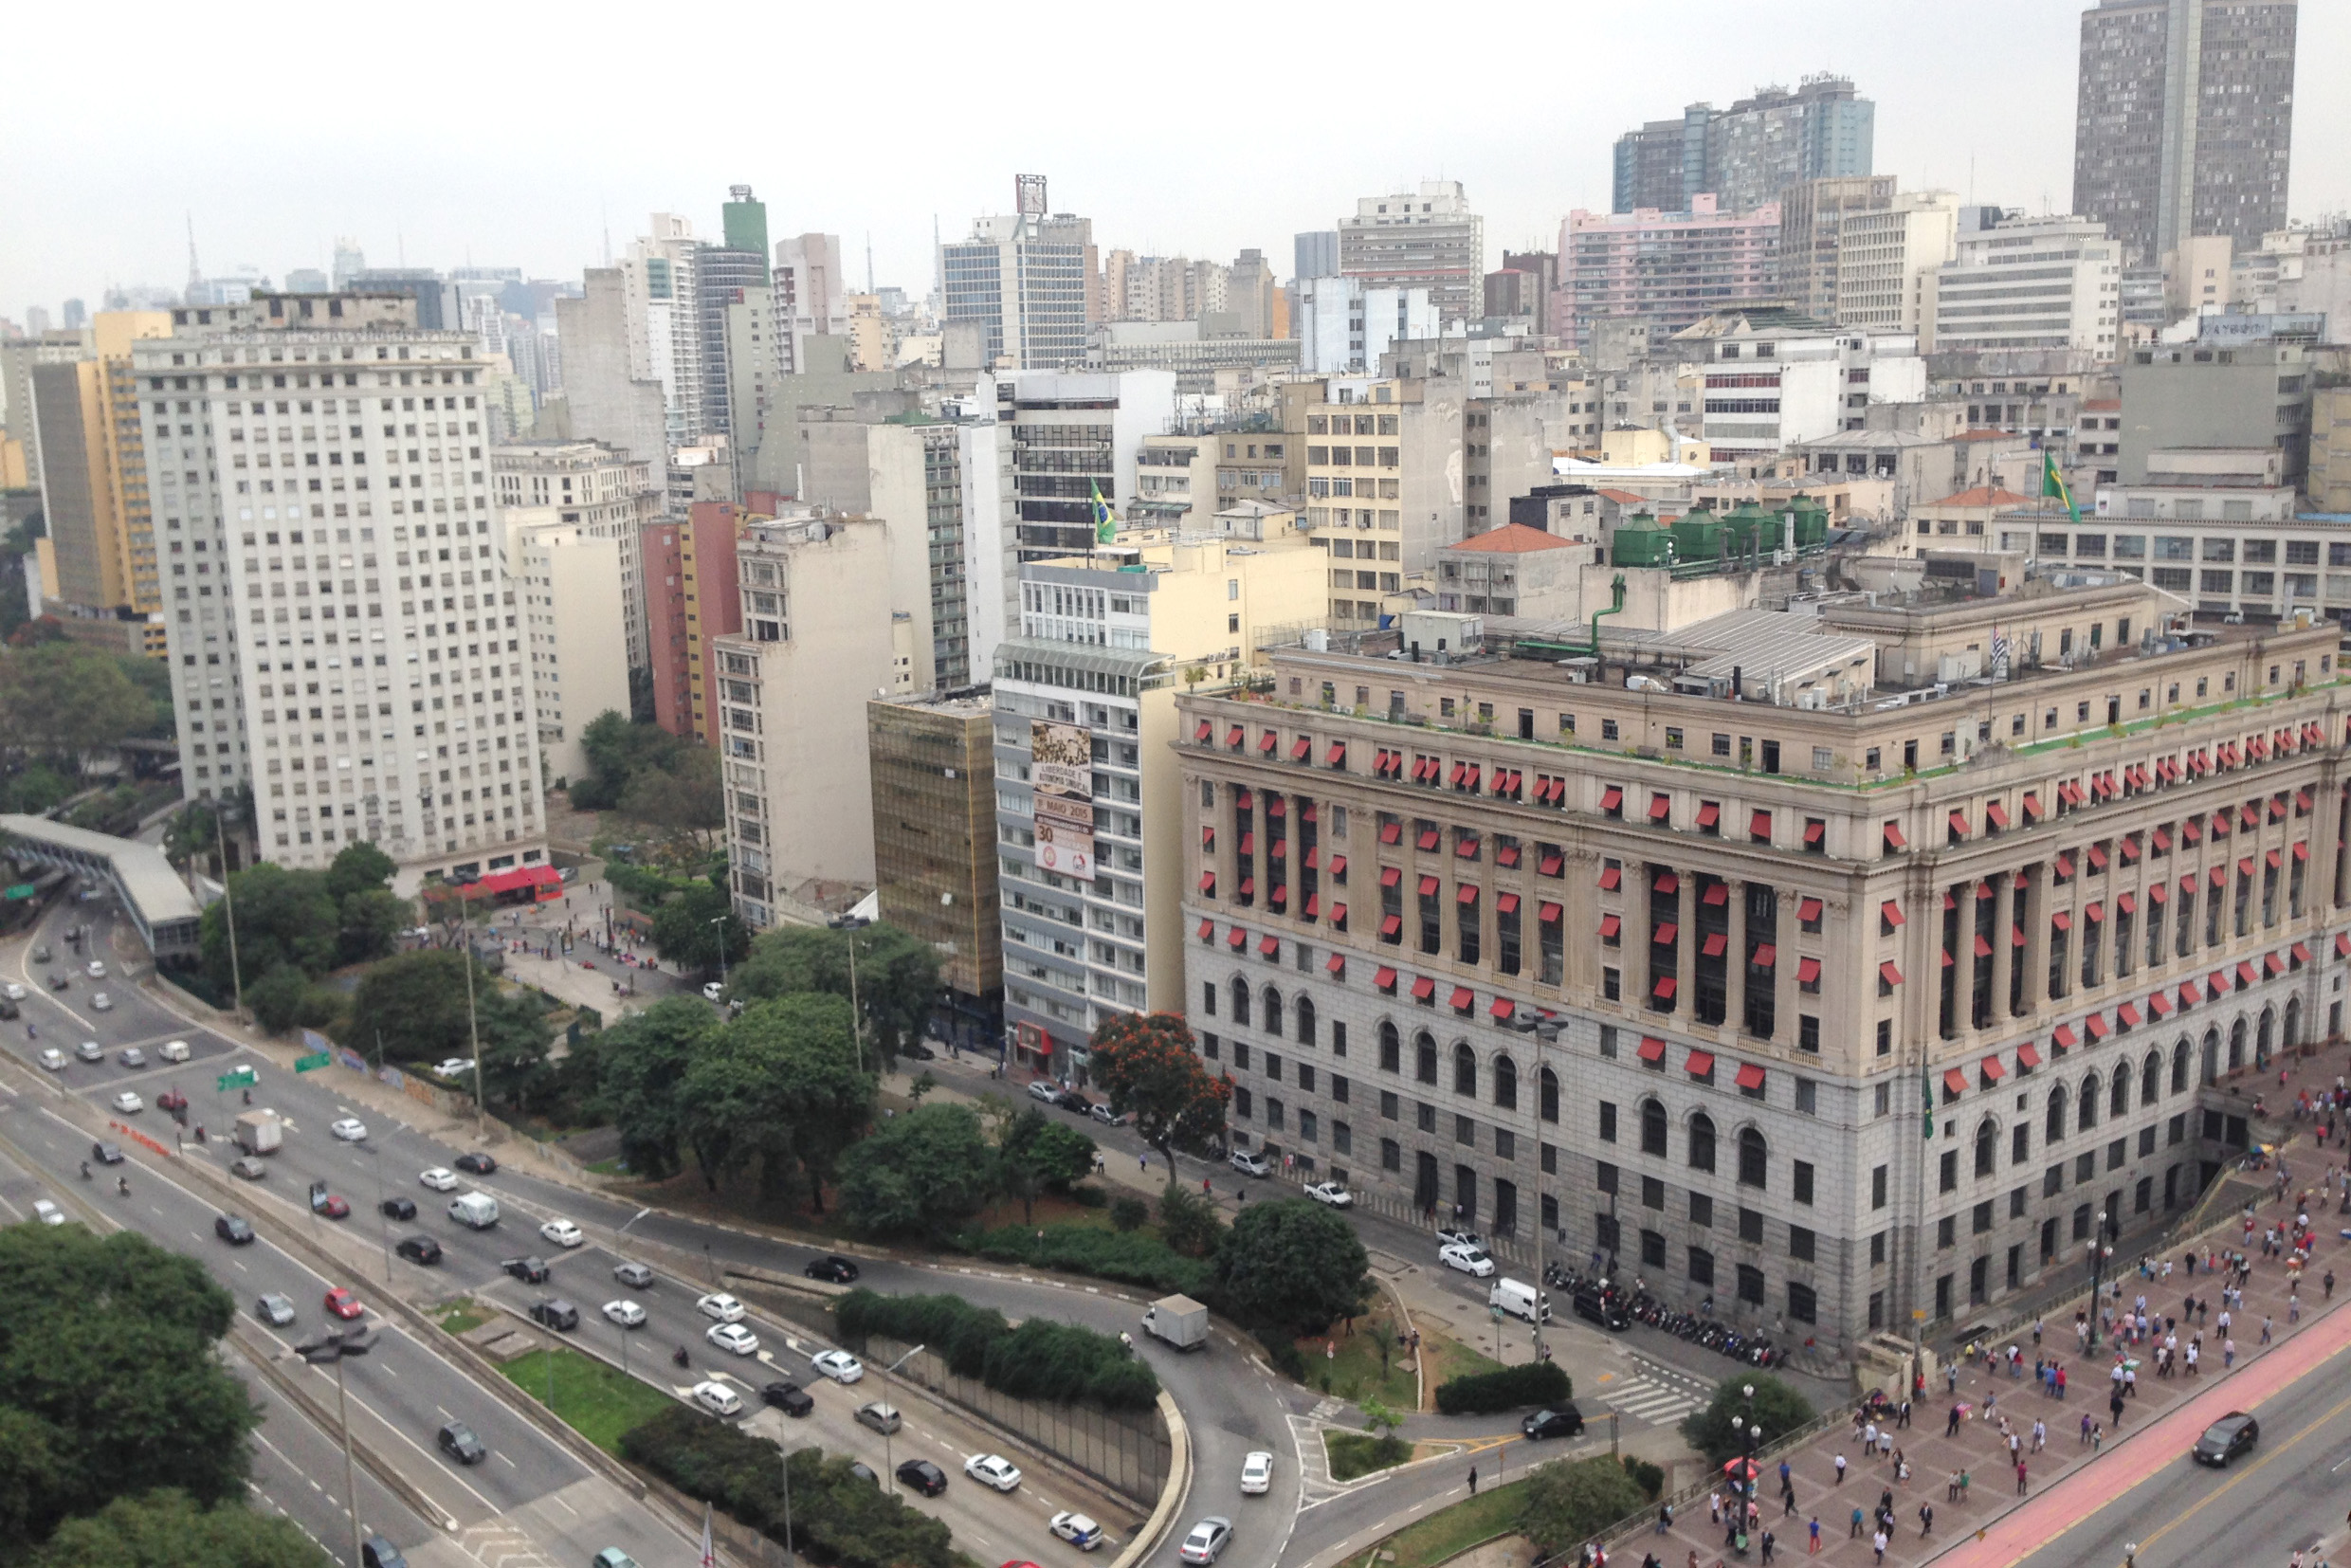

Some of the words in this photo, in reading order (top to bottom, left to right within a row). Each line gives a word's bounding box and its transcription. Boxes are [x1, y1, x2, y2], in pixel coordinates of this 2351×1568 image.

[1042, 766, 1075, 778] LIBERDADE
[1047, 801, 1066, 814] MAIO
[1070, 806, 1088, 819] 2015
[1039, 825, 1053, 843] 30
